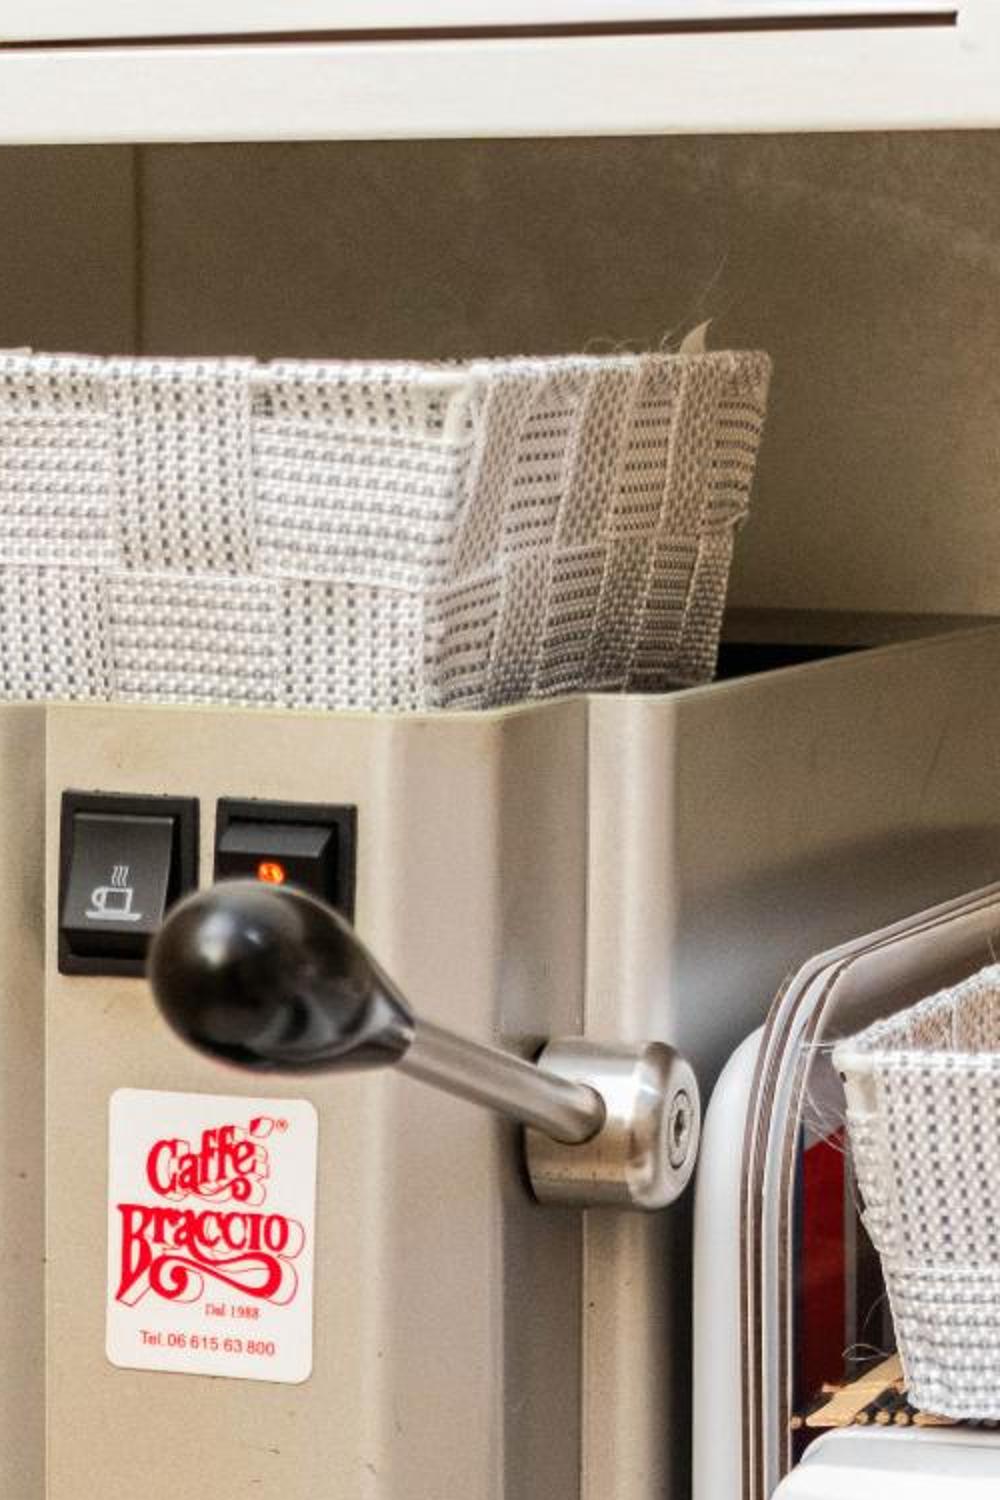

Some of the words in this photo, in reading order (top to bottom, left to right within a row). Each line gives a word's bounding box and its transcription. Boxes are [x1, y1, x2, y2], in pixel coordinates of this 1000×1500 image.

[116, 1203, 300, 1301] Braccio
[190, 1335, 219, 1351] 615
[223, 1338, 243, 1353] 63
[246, 1340, 276, 1356] 800
